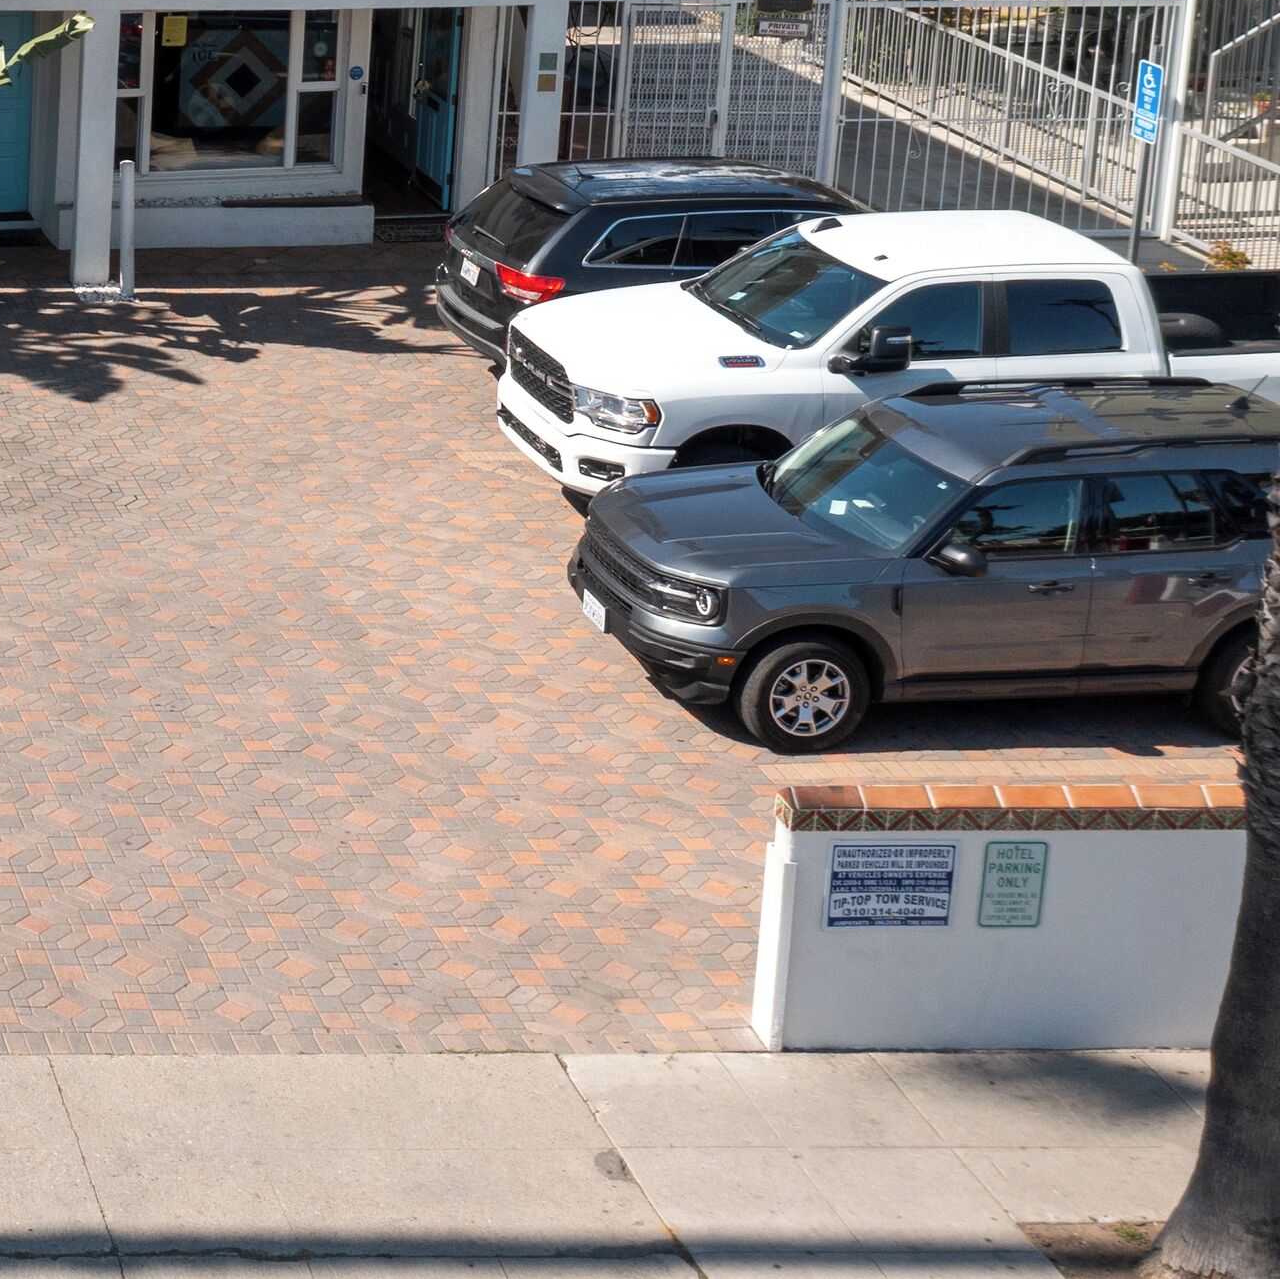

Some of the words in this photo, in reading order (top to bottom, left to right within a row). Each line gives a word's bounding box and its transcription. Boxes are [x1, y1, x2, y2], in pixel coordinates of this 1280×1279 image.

[768, 22, 800, 30] PRIVATE
[837, 848, 892, 859] UNAUTHORIZED
[905, 848, 951, 859] IMPROPERLY
[997, 848, 1035, 859] HOTEL
[837, 860, 860, 869] PARKED
[861, 860, 889, 869] VEHICLES
[890, 860, 904, 869] WILL
[905, 860, 913, 869] BE
[914, 860, 949, 869] IMPOUNDED
[988, 863, 1041, 874] PARKING
[997, 877, 1030, 888] ONLY
[833, 894, 871, 910] TIP-TOP
[875, 894, 901, 904] TOW
[904, 894, 947, 910] SERVICE
